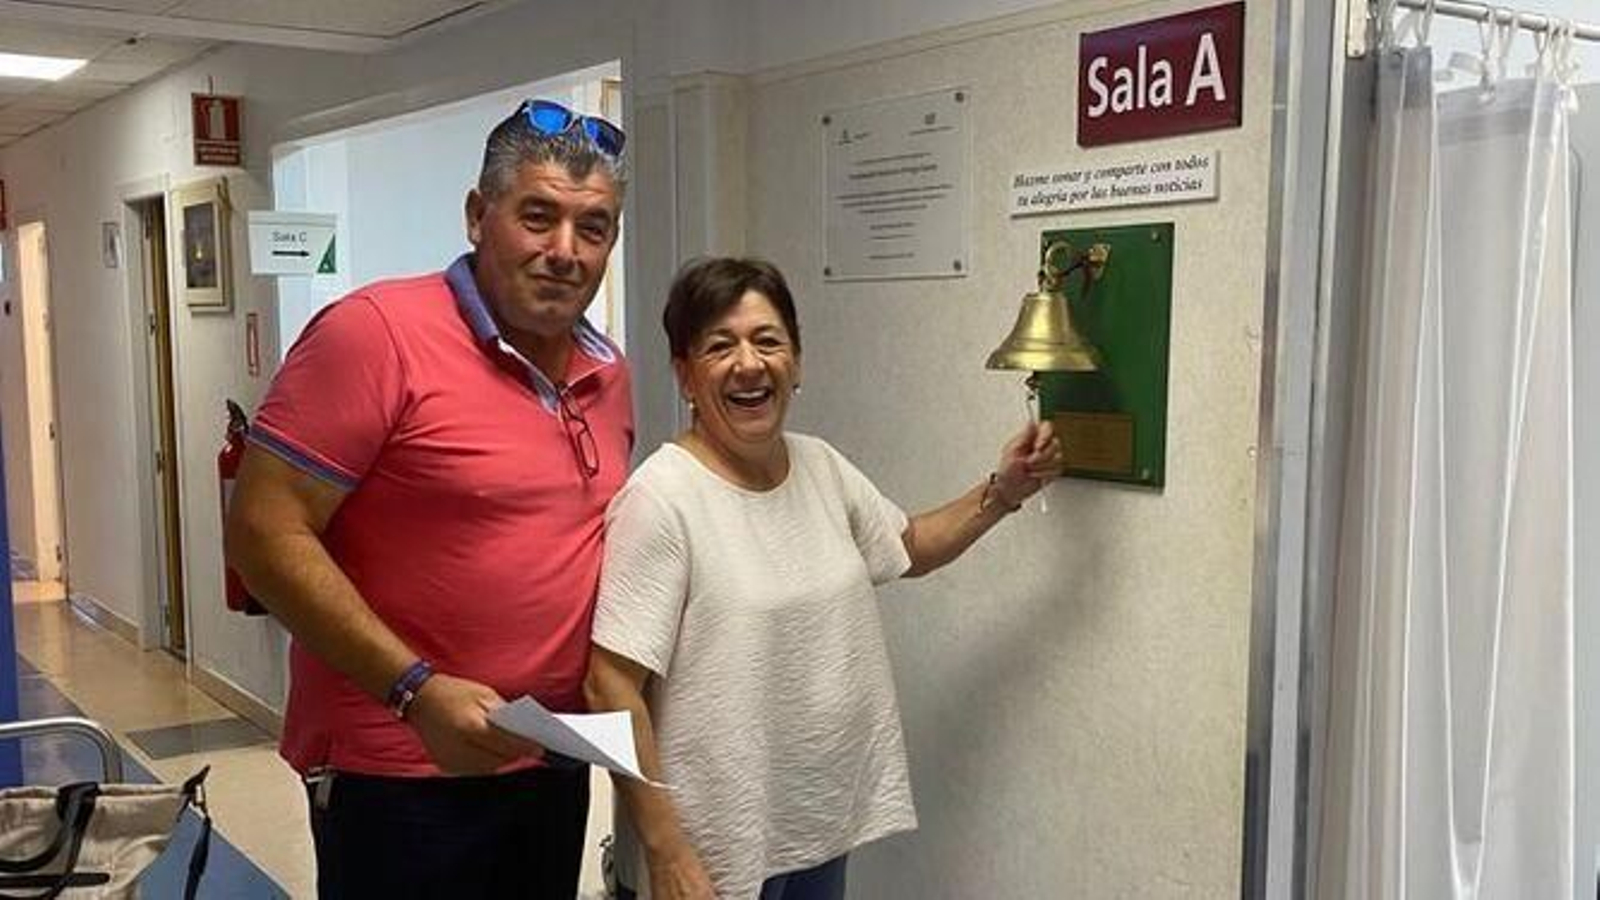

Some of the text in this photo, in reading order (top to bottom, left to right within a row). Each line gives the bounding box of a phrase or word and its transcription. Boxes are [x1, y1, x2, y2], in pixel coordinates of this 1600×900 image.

[1087, 32, 1226, 118] Sala A
[1052, 170, 1082, 184] sonar
[1084, 171, 1092, 184] y
[1094, 163, 1147, 181] comparte
[1150, 161, 1173, 174] con
[1175, 155, 1210, 170] todos
[1069, 190, 1089, 204] por
[1091, 186, 1109, 200] las
[1110, 182, 1151, 197] buenas
[1154, 178, 1203, 194] noticias
[299, 231, 307, 242] C
